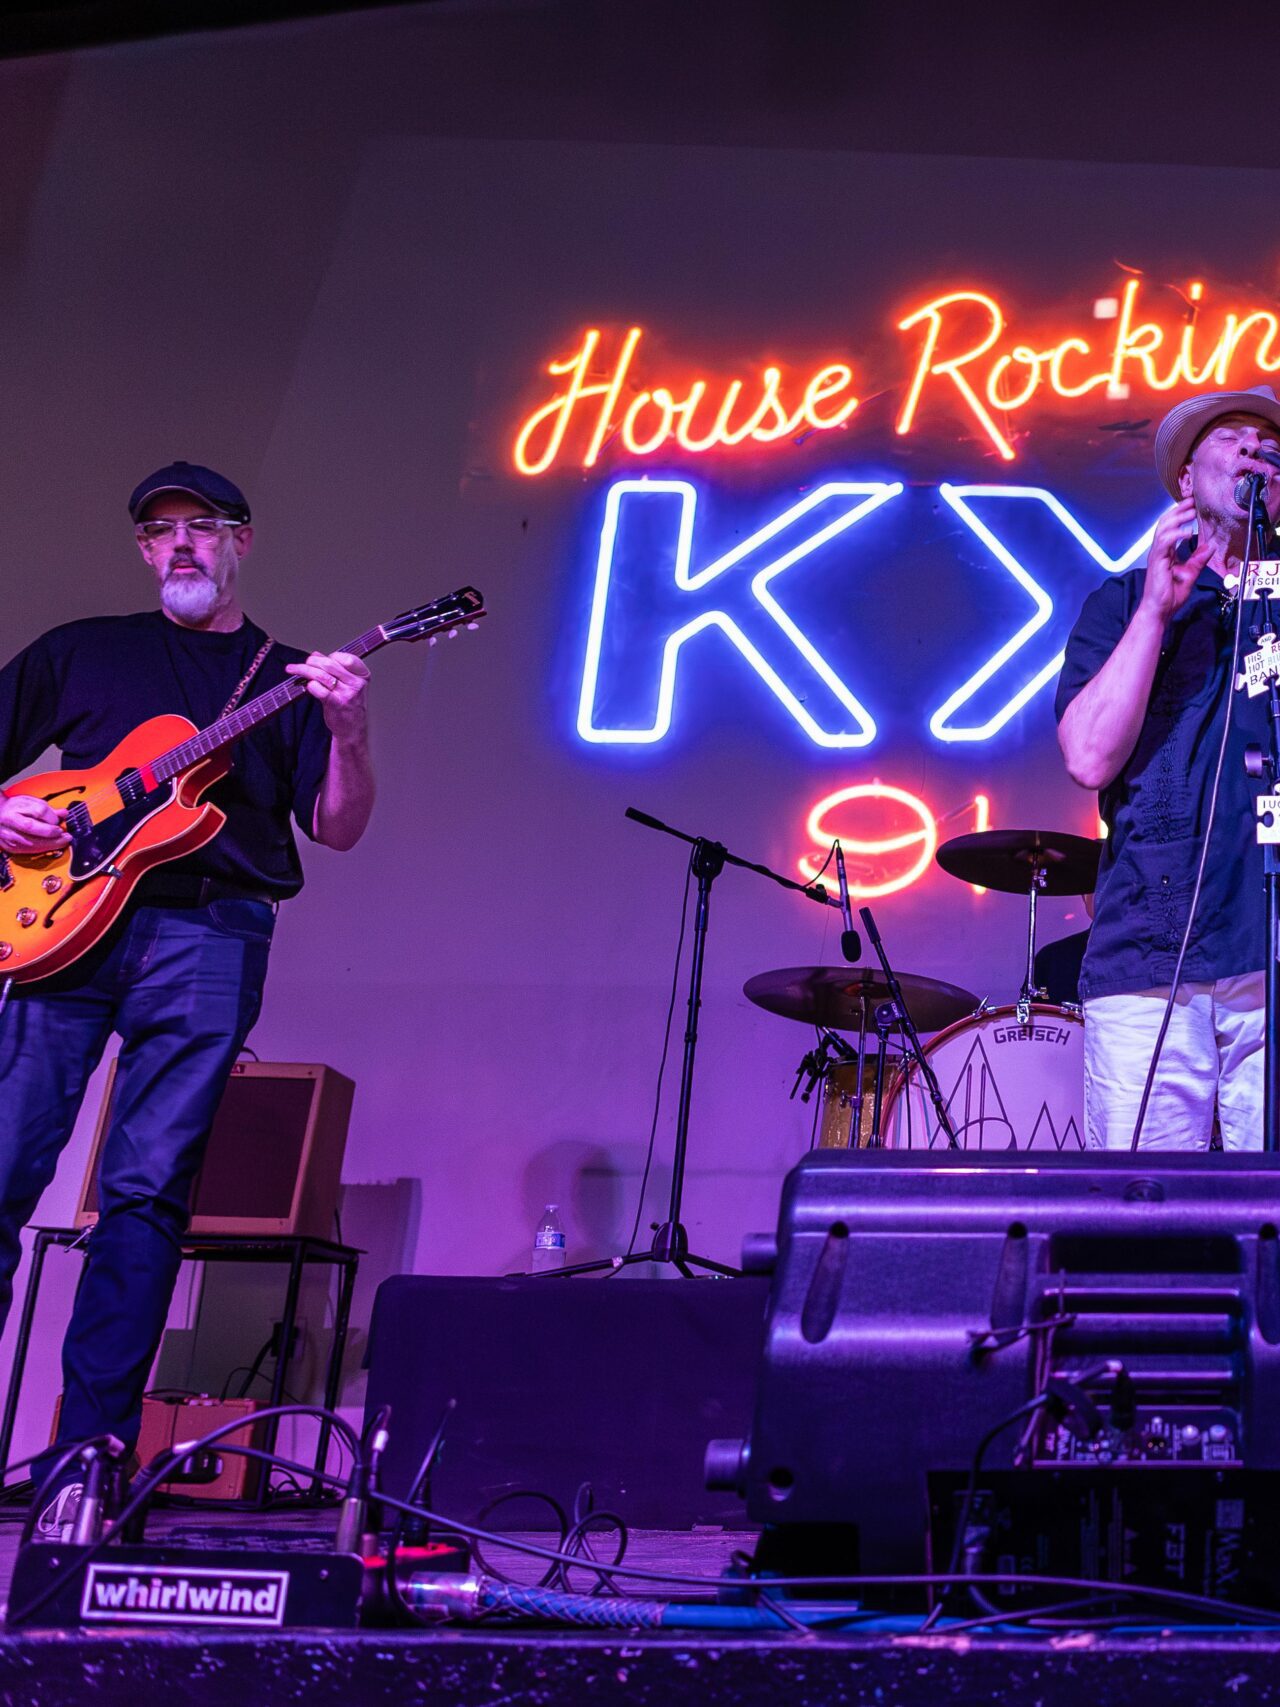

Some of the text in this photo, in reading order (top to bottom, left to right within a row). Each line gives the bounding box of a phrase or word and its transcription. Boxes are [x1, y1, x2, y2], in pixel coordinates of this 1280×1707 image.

[513, 326, 860, 475] House
[1247, 651, 1262, 665] HIS
[1248, 660, 1264, 674] HOT
[993, 1025, 1071, 1046] GRETSCH
[95, 1576, 279, 1613] whirlwind
